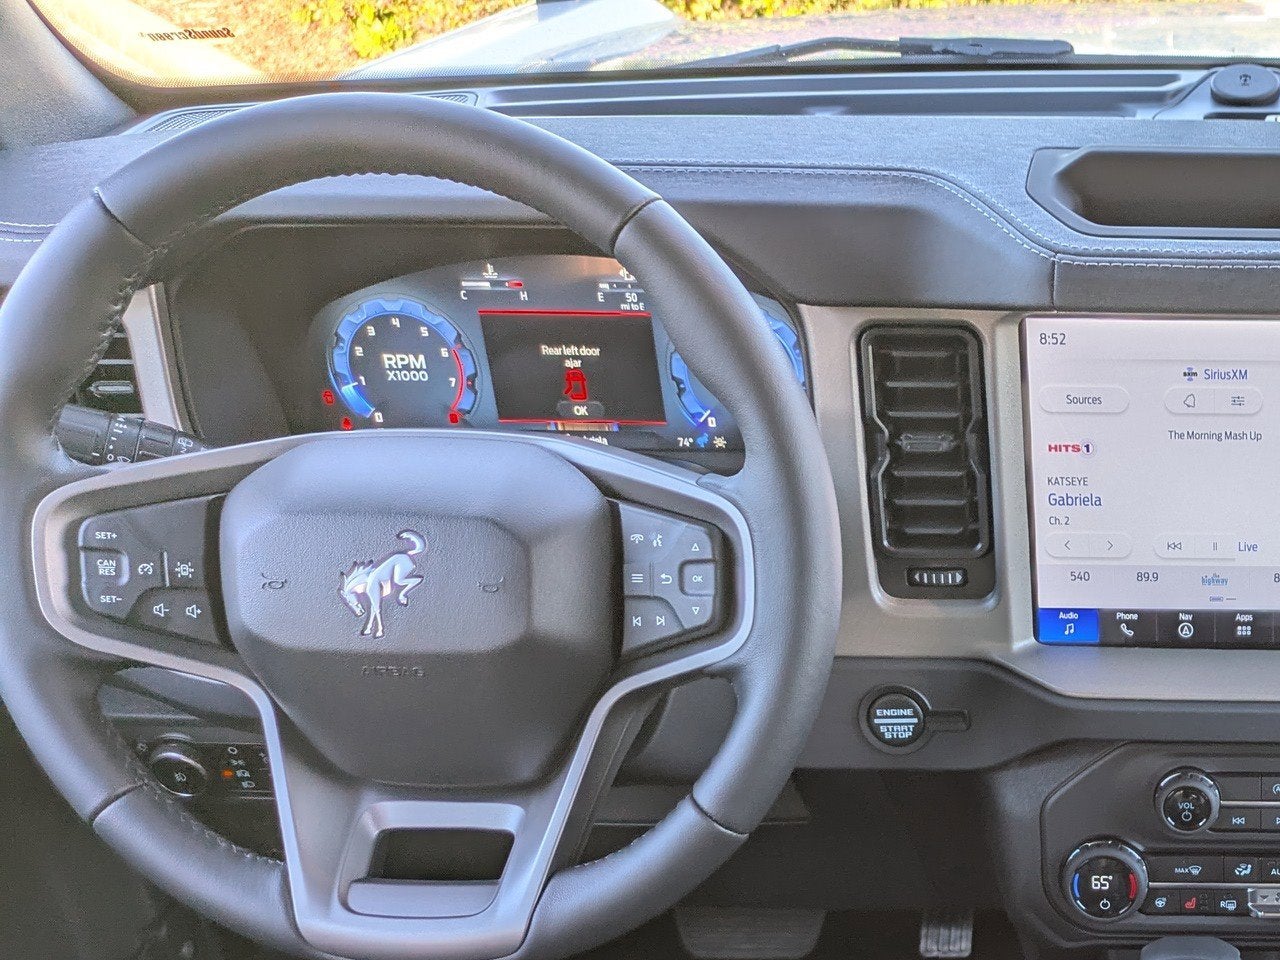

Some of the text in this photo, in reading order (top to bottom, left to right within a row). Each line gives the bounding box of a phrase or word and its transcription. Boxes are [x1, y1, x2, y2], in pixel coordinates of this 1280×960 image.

[460, 290, 468, 301] C
[520, 291, 529, 301] H
[597, 292, 605, 303] E
[625, 292, 638, 304] 50
[391, 317, 401, 328] 4
[366, 325, 376, 337] 3
[420, 326, 429, 337] 5
[1039, 332, 1066, 346] 8:52
[354, 346, 364, 357] 2
[440, 347, 449, 358] 6
[541, 345, 600, 357] Rear left door
[382, 354, 427, 370] RPM
[564, 359, 583, 369] ajar
[386, 370, 429, 382] X1000
[1203, 368, 1249, 381] SiriusXM
[359, 376, 366, 386] 1
[448, 377, 457, 388] 7
[1066, 394, 1103, 405] Sources
[573, 406, 589, 416] OK
[374, 412, 384, 423] 0
[1168, 430, 1262, 444] The Morning Mash Up
[1048, 444, 1081, 453] HITS
[1047, 476, 1089, 487] KATSEYE
[1048, 493, 1102, 507] Gabriela
[1048, 515, 1071, 526] Ch. 2
[95, 531, 118, 540] SET+
[1238, 541, 1259, 552] Live
[97, 559, 116, 567] CAN
[99, 568, 116, 576] RES
[1070, 571, 1091, 582] 540
[1136, 571, 1159, 583] 89.9
[692, 575, 703, 583] OK
[1058, 611, 1079, 620] Audio
[1116, 612, 1139, 621] Phone
[1179, 612, 1194, 621] Nav
[1235, 613, 1254, 623] Apps
[876, 708, 914, 716] ENGINE
[1178, 802, 1195, 810] VOL
[1091, 875, 1113, 890] 65°
